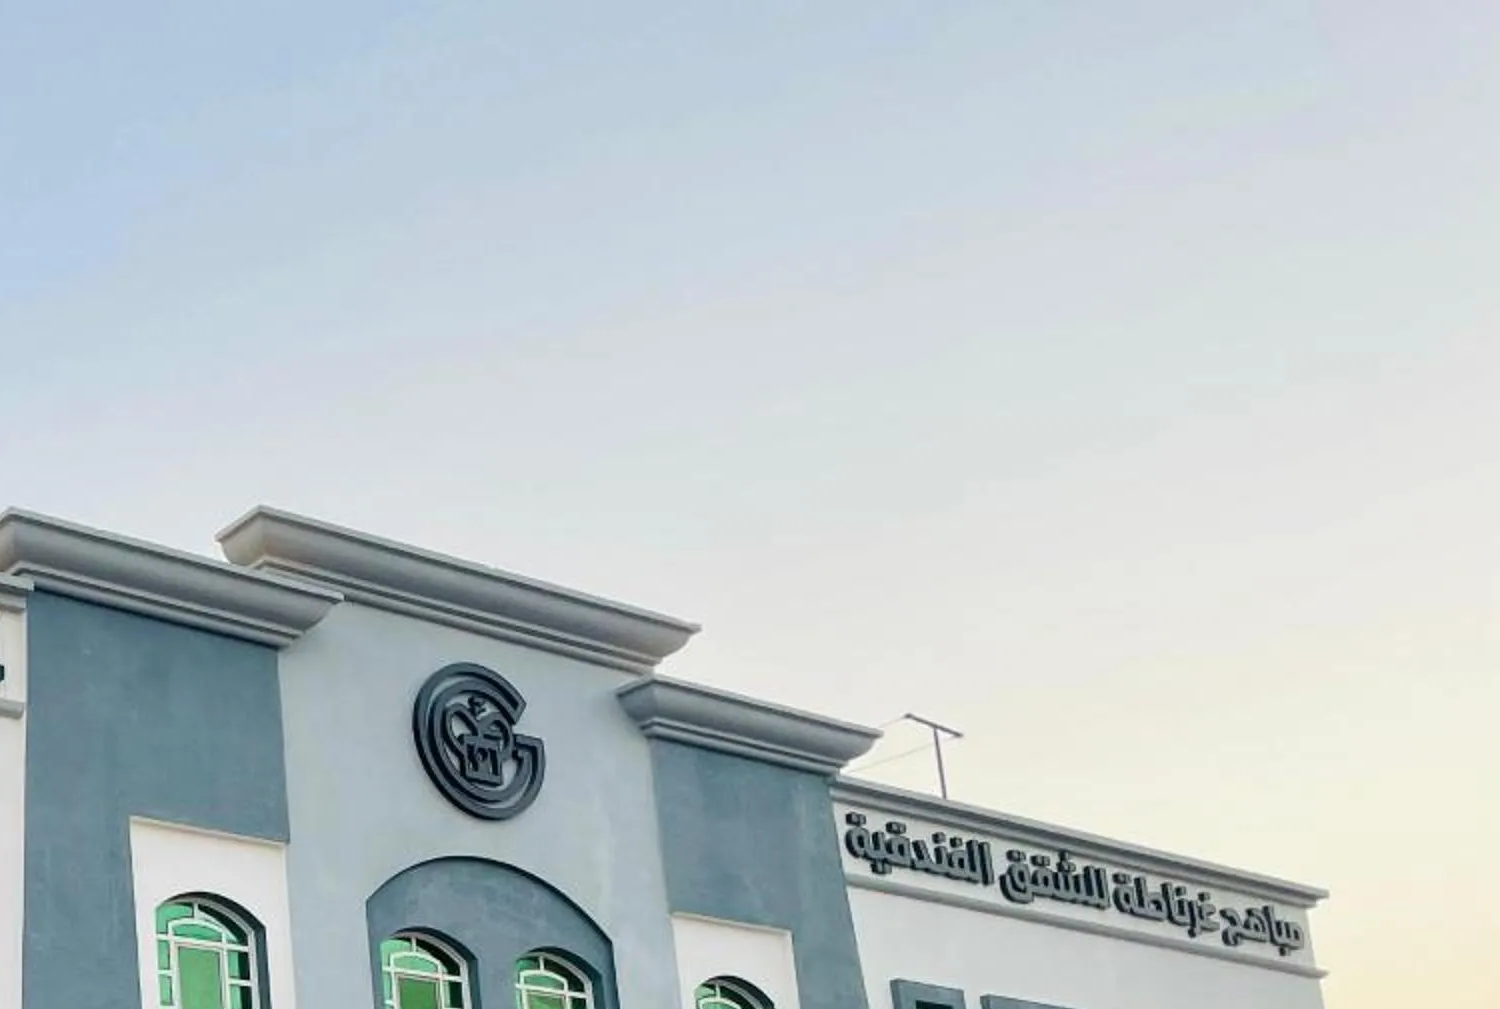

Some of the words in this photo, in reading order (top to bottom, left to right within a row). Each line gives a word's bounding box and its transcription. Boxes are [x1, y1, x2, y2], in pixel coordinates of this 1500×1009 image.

[845, 811, 995, 886] الفندقية
[1112, 873, 1220, 938] غرناطة
[1219, 905, 1305, 957] مباهج
